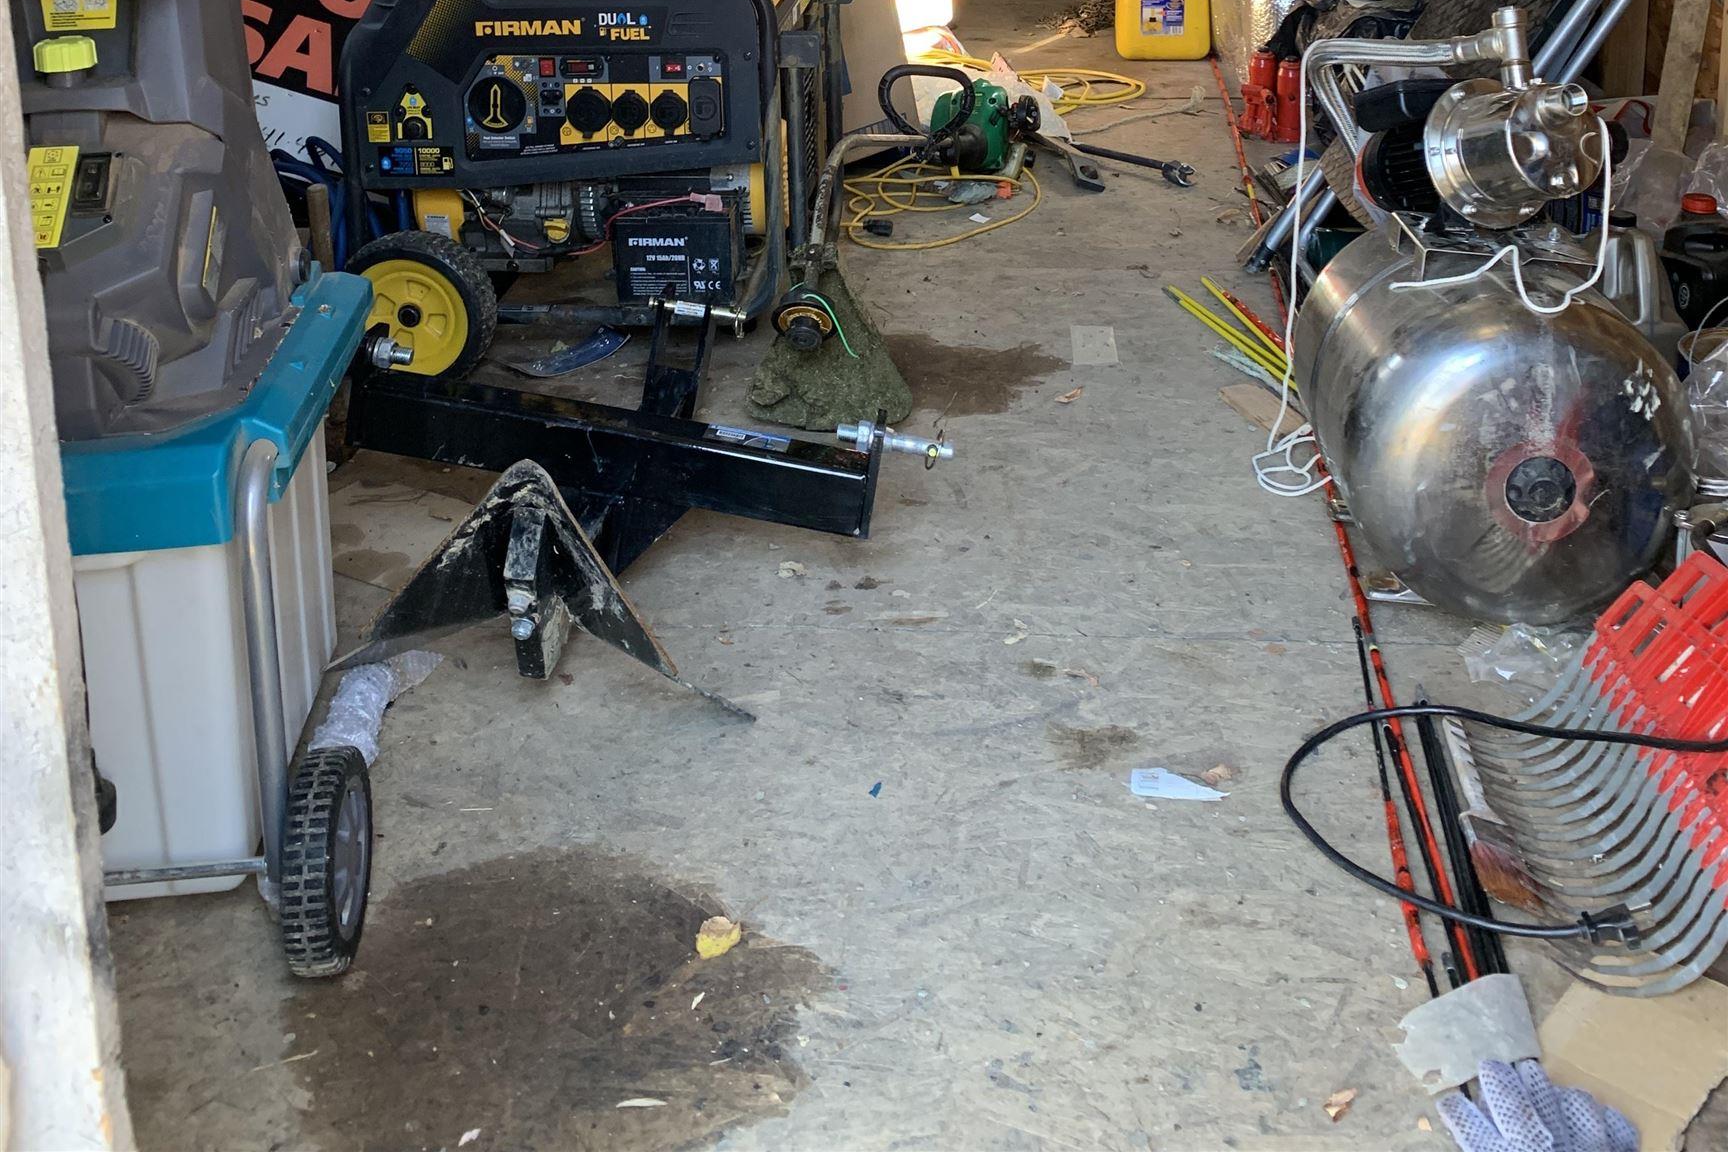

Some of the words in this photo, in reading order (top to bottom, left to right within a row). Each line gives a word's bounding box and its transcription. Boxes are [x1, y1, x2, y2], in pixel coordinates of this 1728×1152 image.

[599, 12, 637, 26] DUAL
[474, 19, 582, 37] FIRMAN
[610, 27, 650, 41] FUEL
[628, 237, 685, 247] FIRMAN
